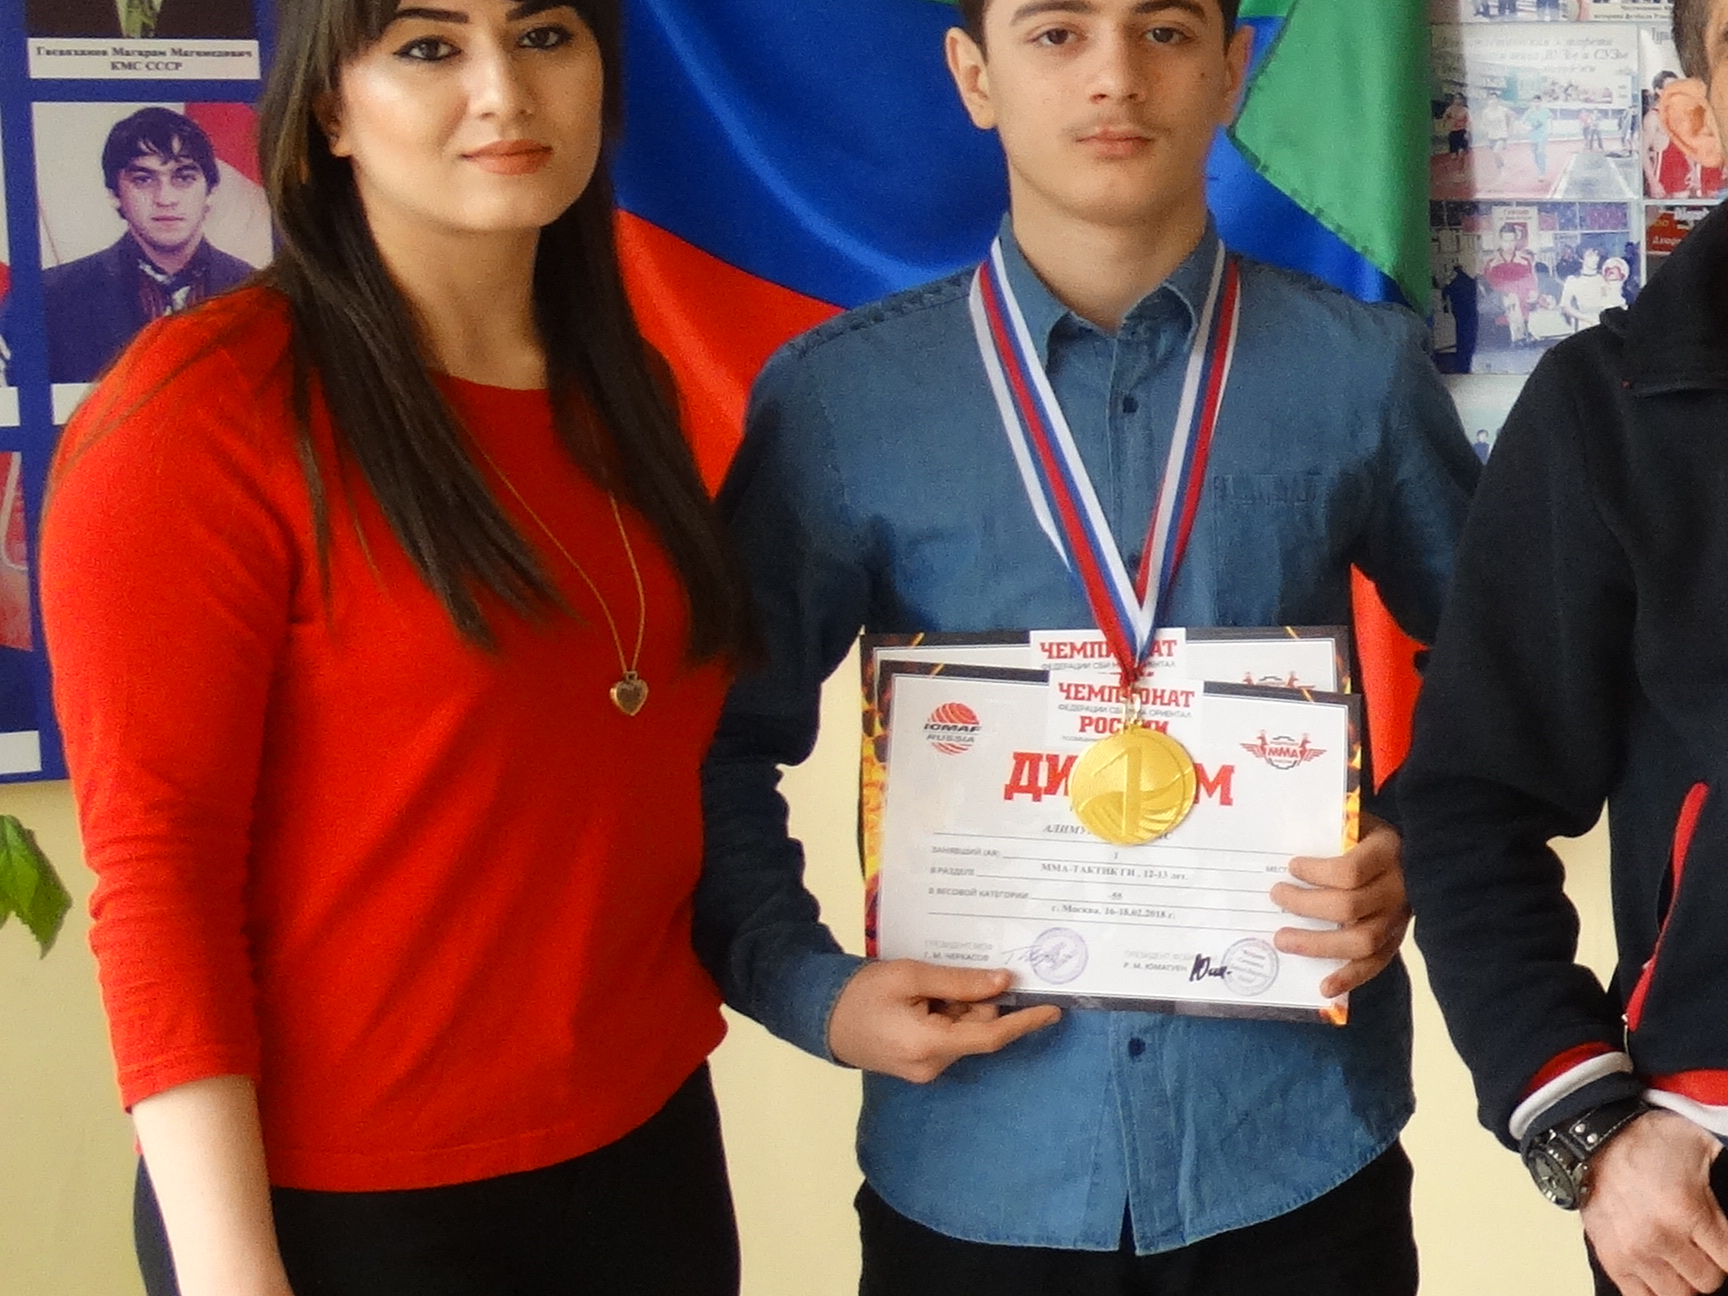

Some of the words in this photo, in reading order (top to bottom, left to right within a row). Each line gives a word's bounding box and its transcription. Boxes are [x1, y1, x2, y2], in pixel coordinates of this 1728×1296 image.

[110, 60, 141, 71] КМС
[145, 61, 182, 71] СССР
[926, 734, 975, 744] RUSSIA
